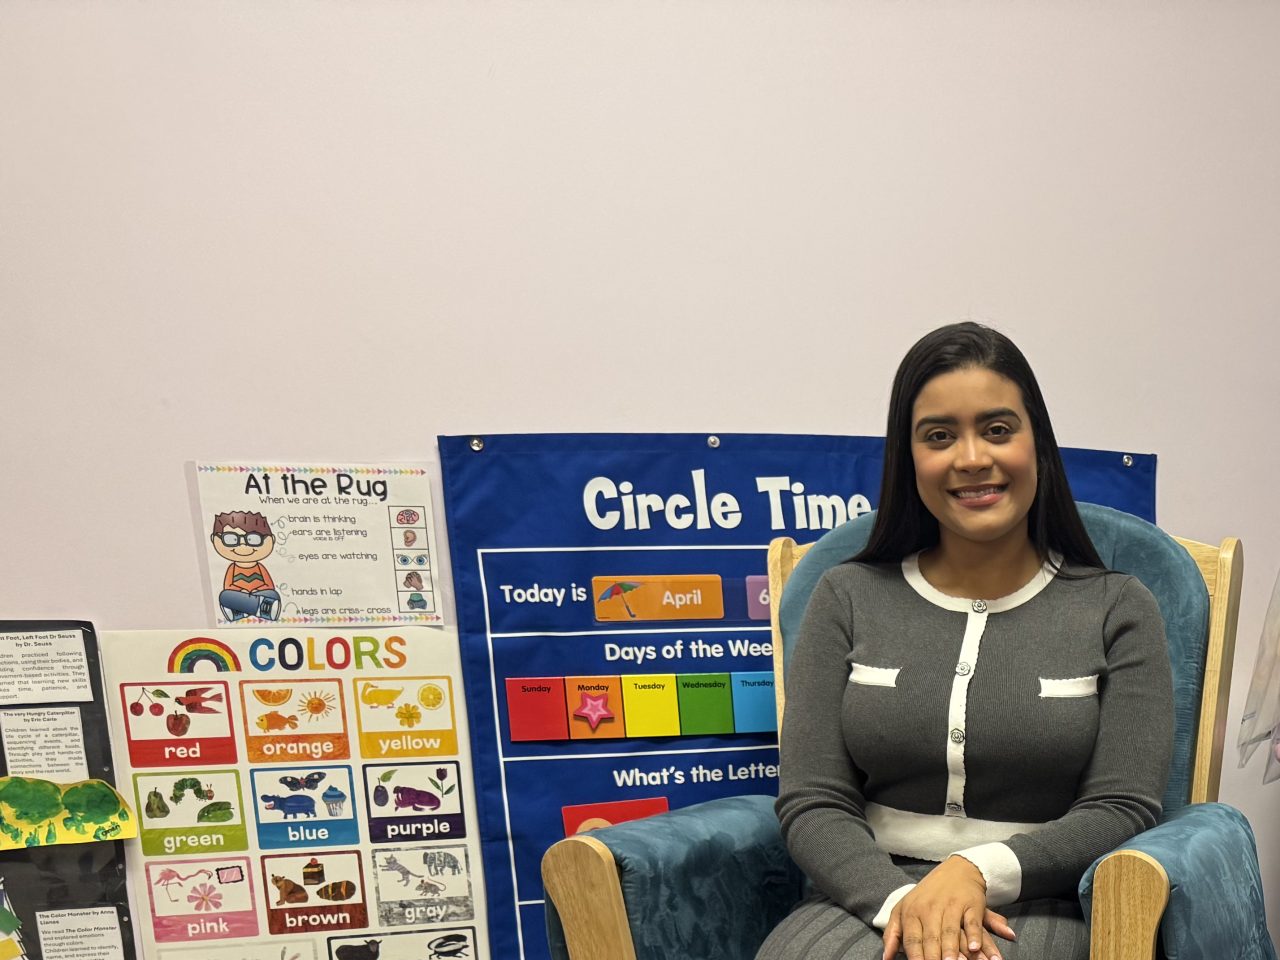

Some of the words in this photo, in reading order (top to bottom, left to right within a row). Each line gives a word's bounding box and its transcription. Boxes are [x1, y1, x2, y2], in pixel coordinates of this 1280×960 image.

[245, 473, 271, 495] At
[281, 474, 327, 495] the
[336, 474, 388, 501] Rug
[259, 496, 285, 505] When
[287, 497, 300, 505] we
[302, 497, 319, 505] are
[321, 496, 331, 505] at
[334, 496, 350, 505] the
[583, 469, 742, 531] Circle
[755, 476, 872, 531] Time
[288, 515, 311, 523] brain
[313, 515, 320, 523] is
[323, 515, 356, 524] thinking
[333, 528, 368, 537] listening
[298, 553, 320, 561] eyes
[339, 552, 377, 561] watching
[291, 587, 318, 596] hands
[320, 588, 328, 596] in
[329, 588, 342, 597] lap
[500, 585, 565, 606] Today
[571, 585, 587, 602] is
[662, 589, 702, 607] April
[759, 589, 770, 605] 6
[301, 606, 319, 615] legs
[321, 607, 337, 615] are
[367, 606, 392, 615] cross
[249, 636, 407, 672] COLORS
[605, 643, 657, 663] Days
[662, 641, 685, 659] of
[689, 641, 725, 658] the
[728, 639, 773, 657] Wee
[521, 684, 551, 694] Sunday
[577, 684, 610, 694] Monday
[633, 682, 665, 692] Tuesday
[682, 680, 726, 690] Wednesday
[741, 679, 774, 688] Thursday
[164, 743, 201, 759] red
[262, 740, 334, 758] orange
[378, 733, 441, 753] yellow
[613, 766, 684, 787] What's
[690, 764, 724, 783] the
[287, 823, 329, 842] blue
[386, 818, 451, 839] purple
[164, 830, 224, 853] green
[284, 909, 351, 928] brown
[404, 902, 447, 922] gray
[187, 917, 229, 937] pink
